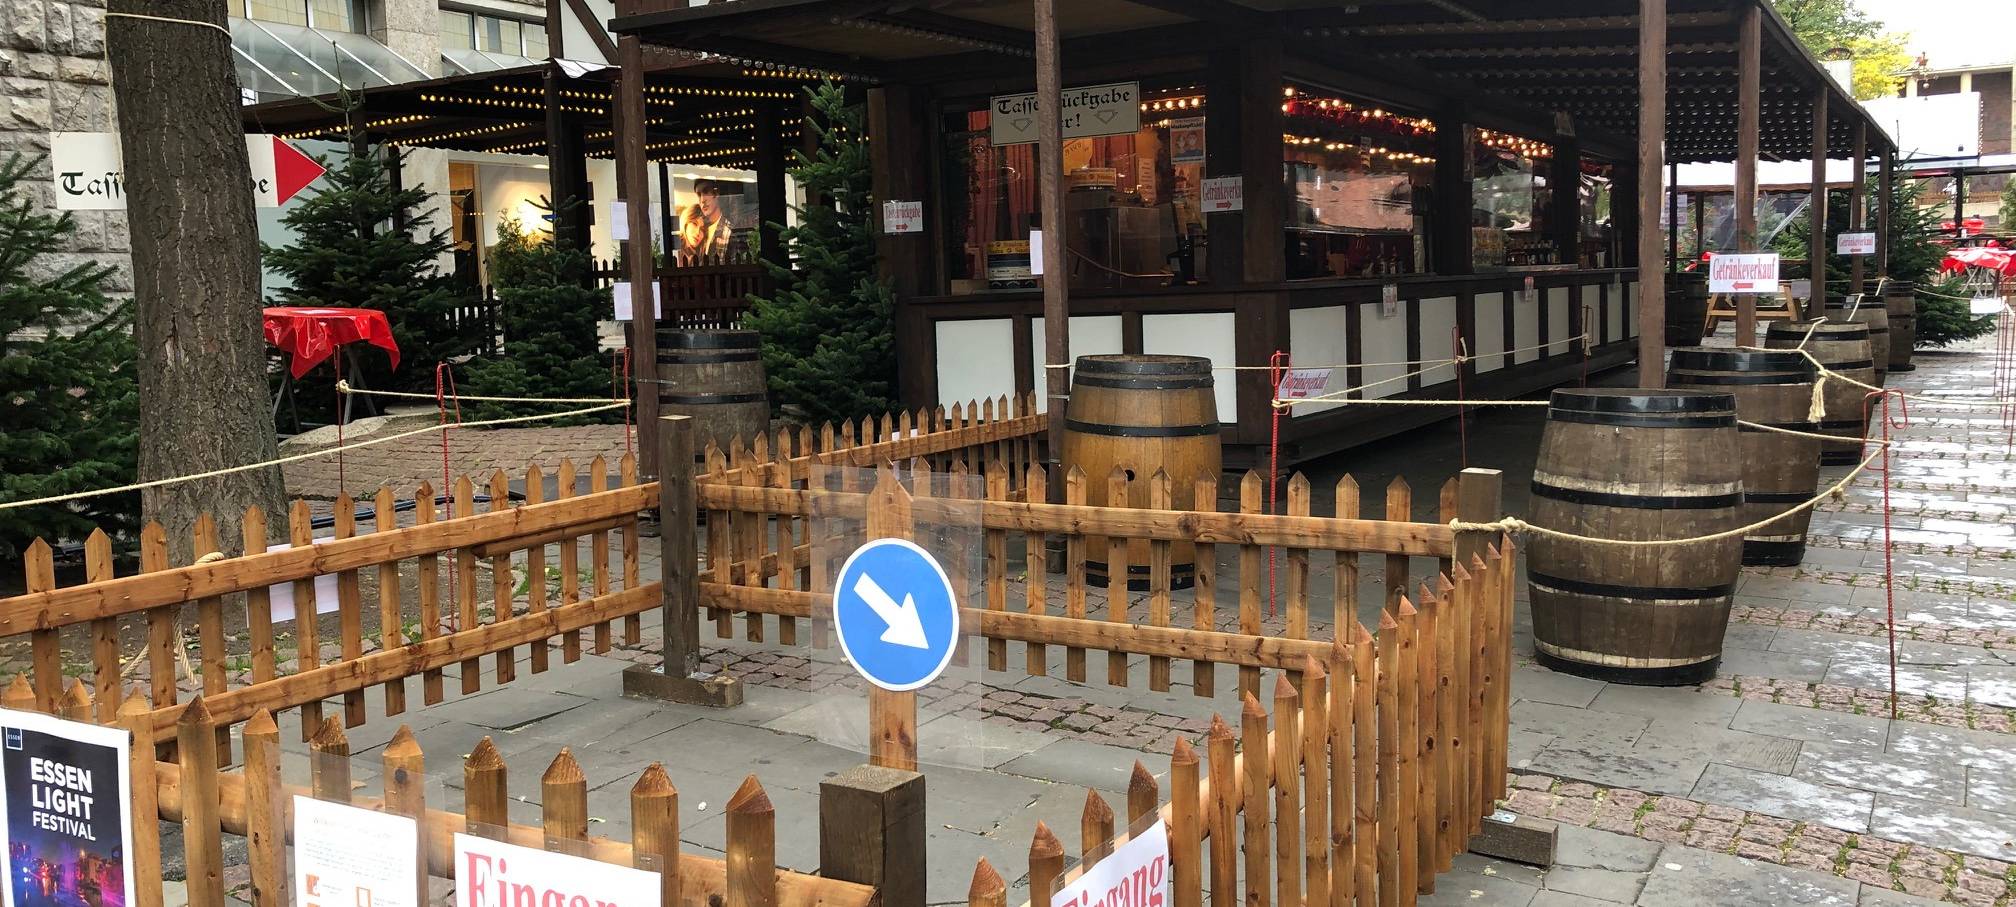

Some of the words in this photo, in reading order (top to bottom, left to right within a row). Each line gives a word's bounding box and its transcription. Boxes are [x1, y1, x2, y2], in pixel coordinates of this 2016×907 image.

[996, 88, 1130, 115] Tasseückgabe
[1713, 256, 1776, 281] Getränkeverkauf
[31, 757, 93, 794] ESSEN
[32, 784, 94, 820] LIGHT
[33, 811, 96, 841] FESTIVAL
